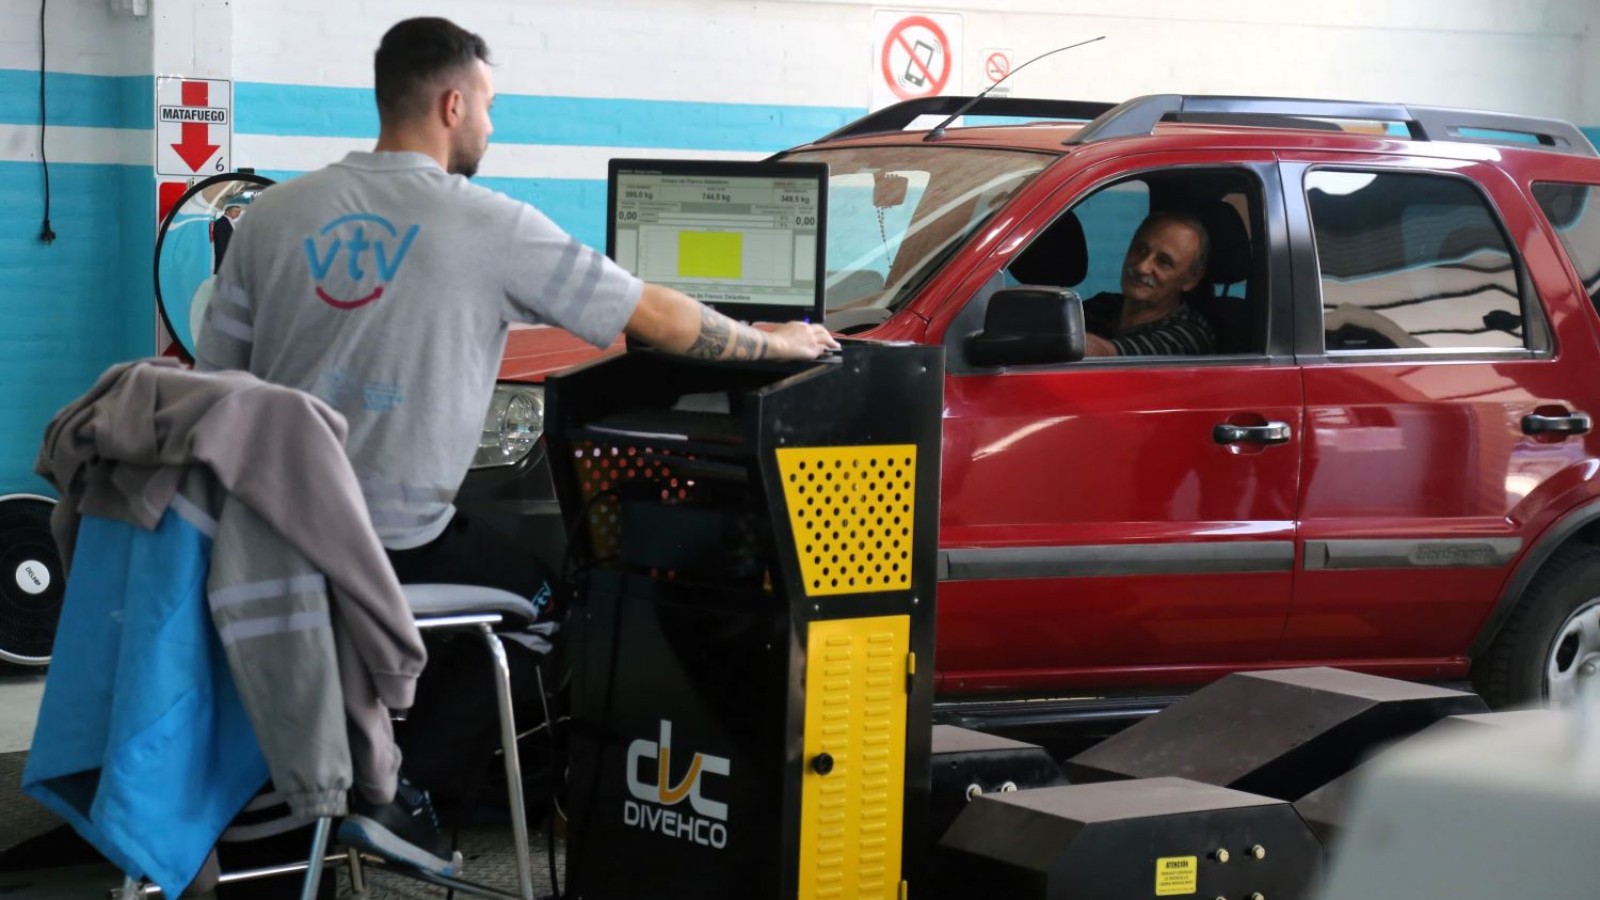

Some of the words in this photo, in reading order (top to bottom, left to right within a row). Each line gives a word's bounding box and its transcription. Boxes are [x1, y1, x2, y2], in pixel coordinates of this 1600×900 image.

[162, 108, 225, 122] MATAFUEGO
[215, 156, 225, 172] 6
[722, 192, 731, 202] kg
[618, 211, 638, 221] 0,00
[795, 217, 815, 227] 0,00
[624, 800, 727, 849] DIVEHCO
